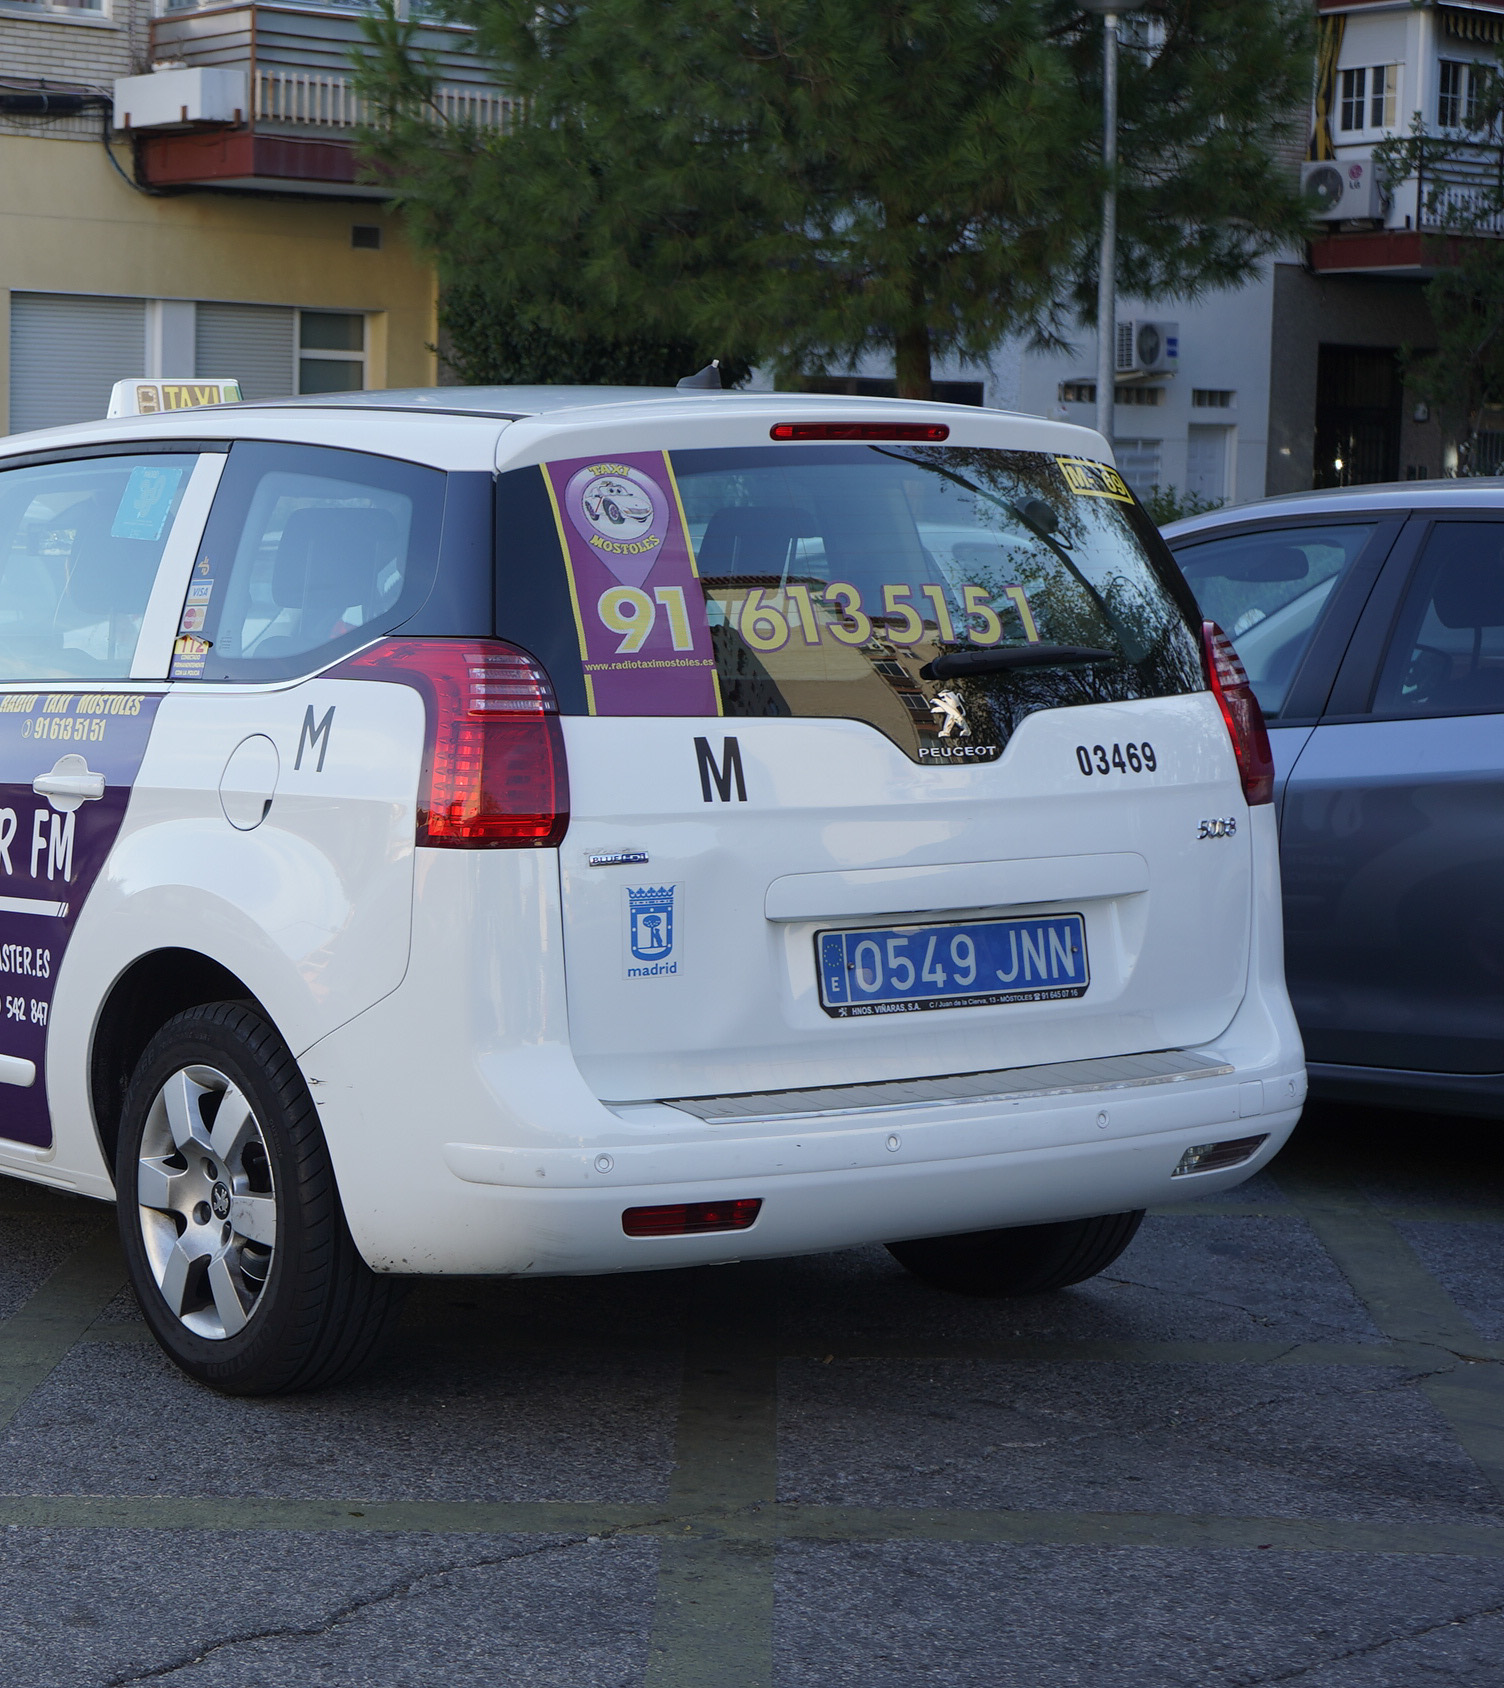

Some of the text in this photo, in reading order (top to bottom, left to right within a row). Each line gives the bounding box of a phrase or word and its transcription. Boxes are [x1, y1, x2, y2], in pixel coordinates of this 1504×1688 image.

[164, 386, 220, 409] TAXI
[589, 464, 630, 476] TAXI
[589, 535, 660, 555] MOSTOLES
[193, 587, 209, 597] VISA
[597, 585, 695, 654] 91
[584, 658, 714, 671] www.radiotaximostoles.es
[0, 694, 145, 716] RADIO TAXI MOSTOLES
[294, 704, 336, 772] M
[918, 745, 996, 758] PEUGEOT
[1076, 741, 1158, 776] 03469
[693, 736, 747, 802] M
[30, 809, 76, 882] FM
[627, 962, 678, 977] madrid
[831, 926, 1076, 993] E 0549 JNN
[852, 1006, 875, 1016] HNOS.
[907, 1002, 922, 1012] S.A.
[938, 1000, 954, 1008] Juan
[1041, 992, 1049, 1000] 91
[1050, 990, 1062, 999] 645
[1062, 990, 1069, 998] 07
[1070, 989, 1078, 997] 16
[5, 996, 26, 1022] 542
[30, 999, 48, 1026] 847
